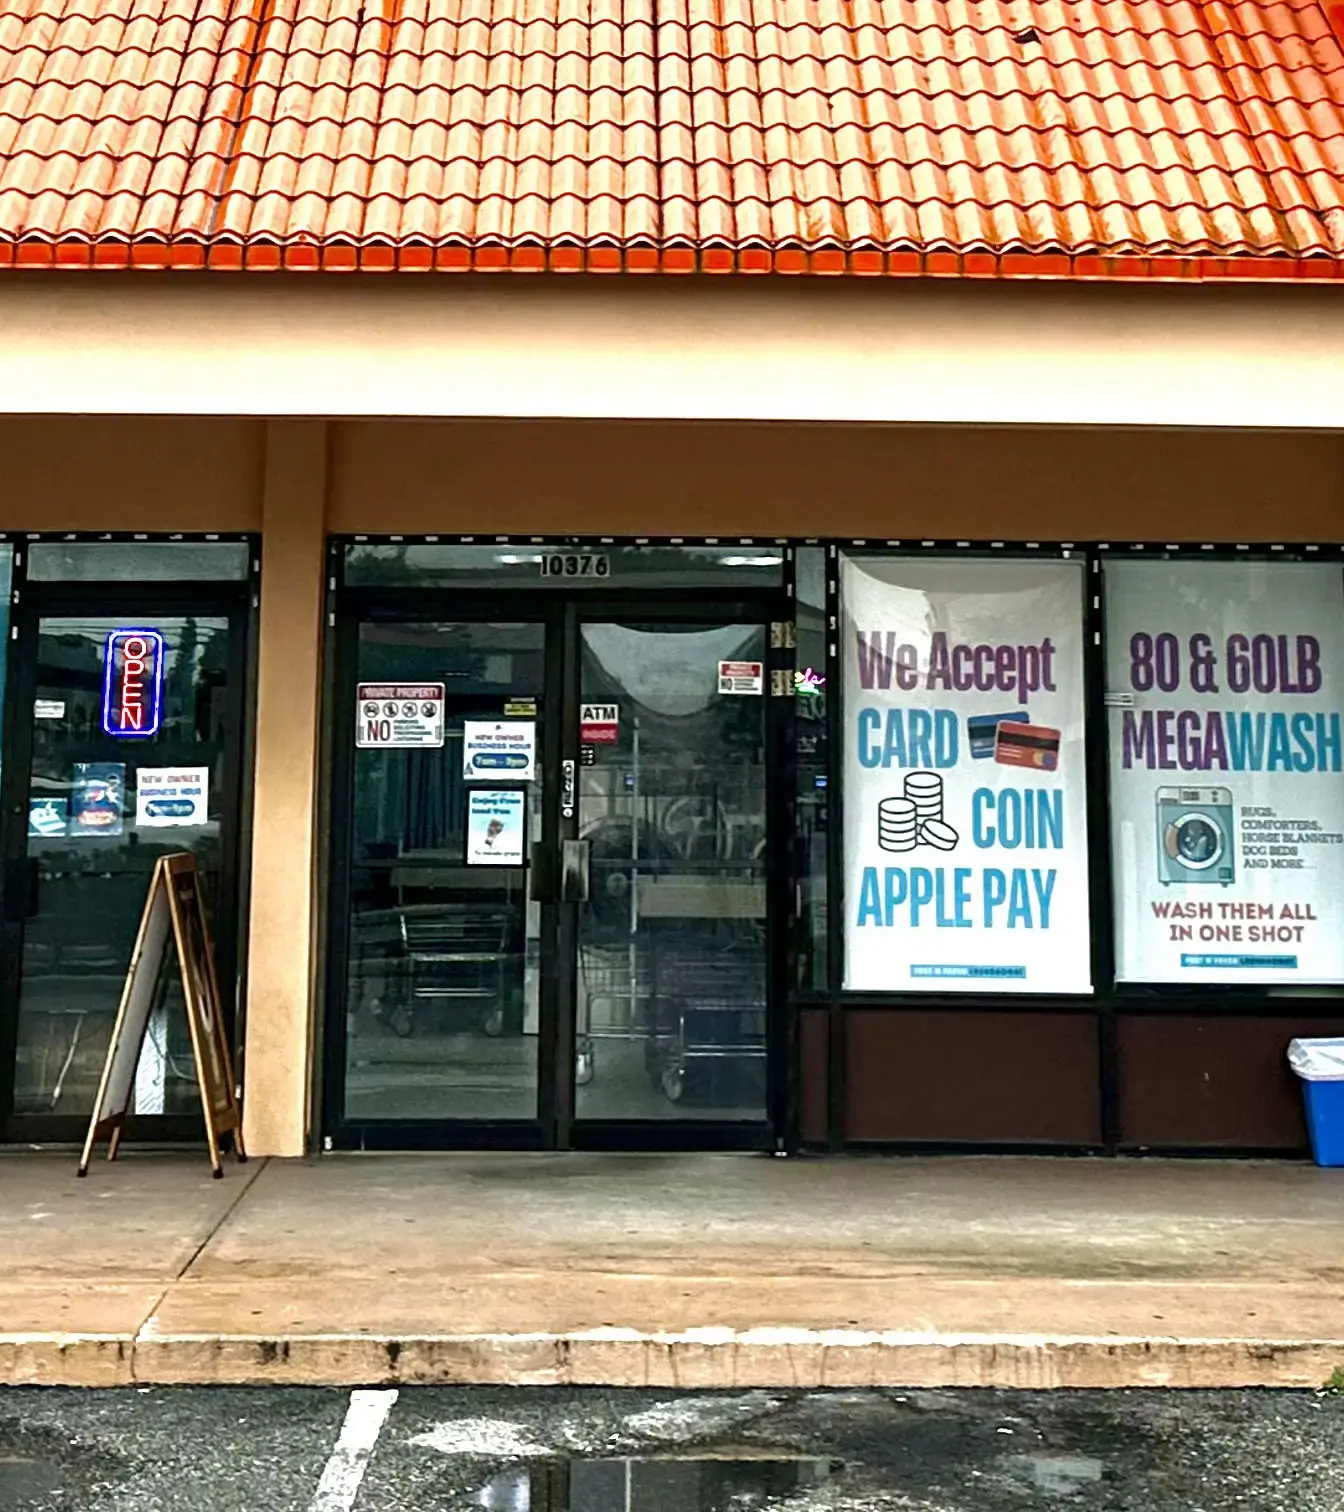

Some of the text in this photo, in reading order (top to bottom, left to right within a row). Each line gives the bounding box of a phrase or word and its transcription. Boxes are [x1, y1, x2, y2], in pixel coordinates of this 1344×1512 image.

[541, 555, 609, 577] 10376
[120, 635, 147, 730] OPEN
[857, 631, 918, 690] We
[927, 631, 1057, 704] Accept
[1130, 631, 1322, 694] 80 & 60LB
[367, 719, 391, 741] NO
[582, 707, 616, 720] ATM
[857, 708, 958, 769] CARD
[1121, 710, 1343, 772] MEGAWASH
[972, 787, 1064, 850] COIN
[856, 866, 1057, 929] APPLE PAY
[1151, 901, 1317, 920] WASH THEM ALL
[1169, 924, 1305, 942] IN ONE SHOT
